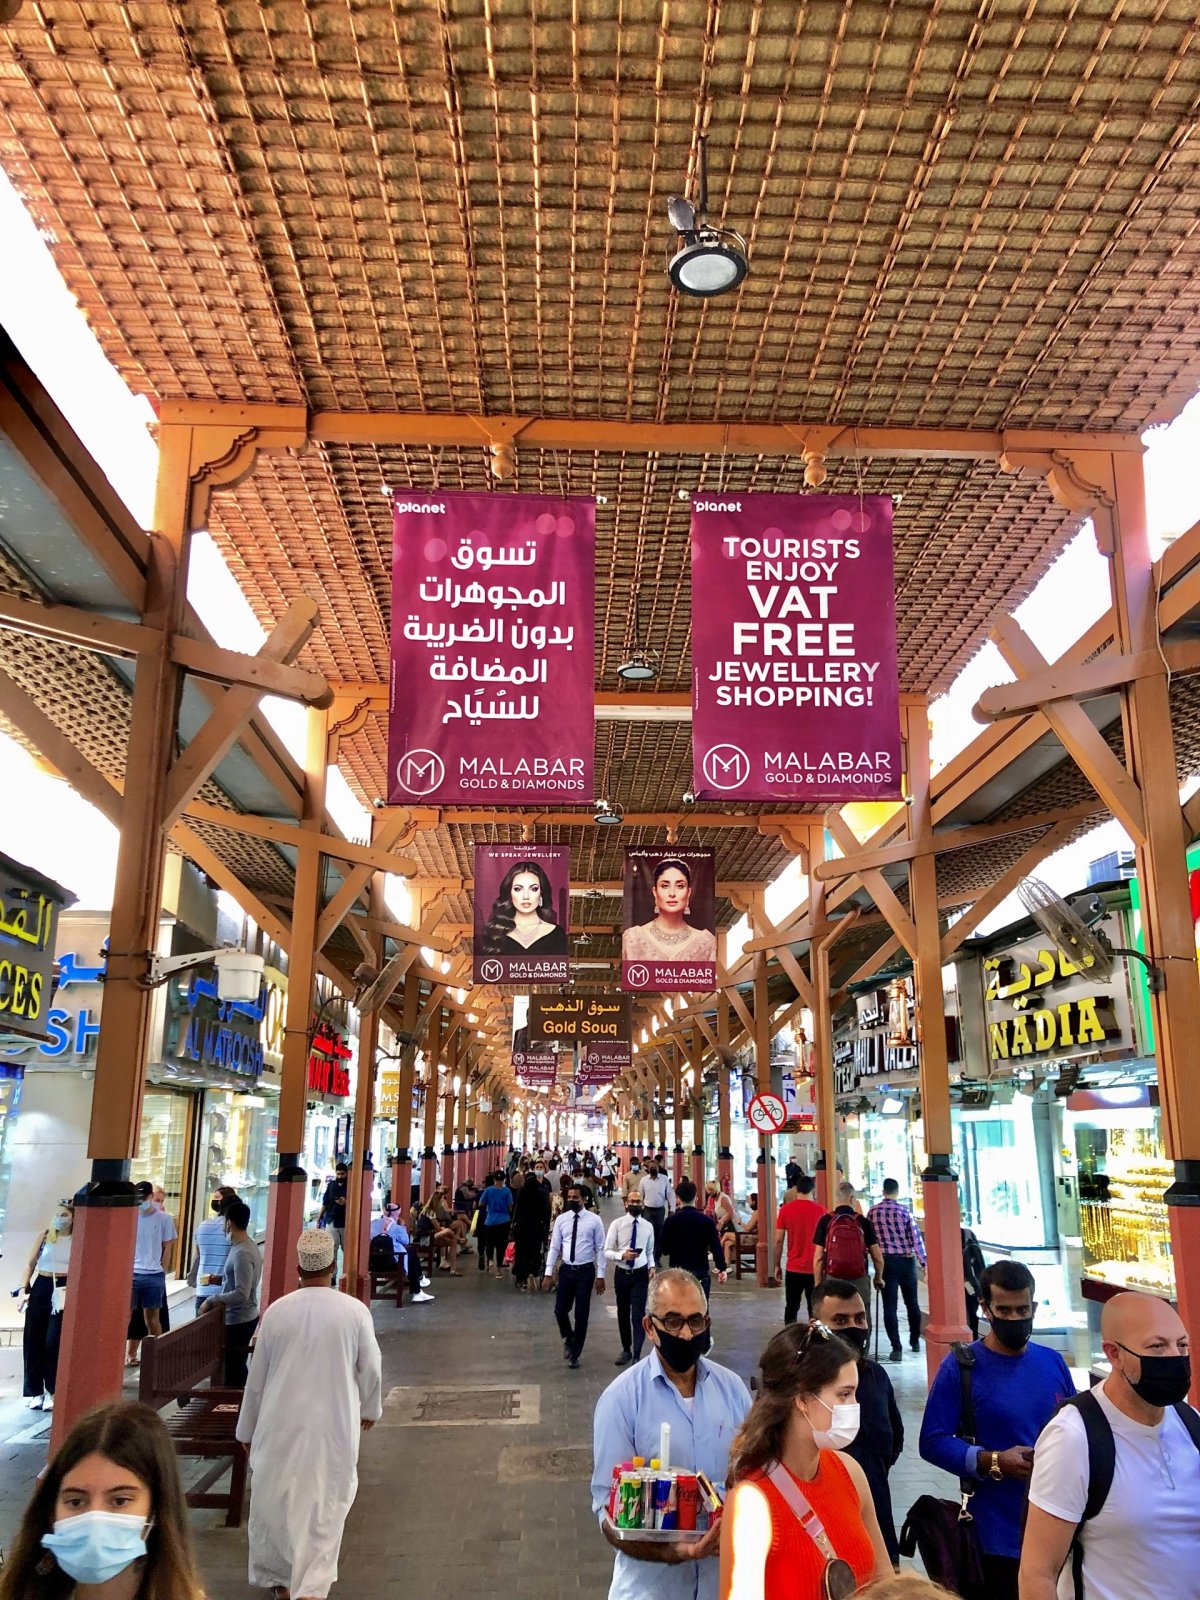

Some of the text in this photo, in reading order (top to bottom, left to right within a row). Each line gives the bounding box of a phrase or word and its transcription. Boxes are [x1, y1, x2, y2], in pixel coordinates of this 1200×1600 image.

[396, 502, 446, 514] planet
[693, 501, 742, 513] planet
[450, 538, 537, 571] تسوق
[723, 537, 860, 559] TOURISTS
[746, 560, 839, 582] ENJOY
[419, 576, 566, 612] المجوهرات
[747, 585, 838, 619] VAT
[403, 614, 574, 651] بدون الضريبة
[733, 622, 856, 657] FREE
[429, 654, 548, 685] المضافة
[708, 661, 880, 683] JEWELLERY
[716, 686, 873, 707] SHOPPING!
[459, 757, 585, 776] MALABAR
[764, 751, 891, 770] MALABAR
[459, 778, 585, 790] GOLD & DIAMONDS
[765, 772, 892, 784] GOLD & DIAMONDS
[509, 962, 567, 972] MALABAR
[655, 968, 713, 978] MALABAR
[540, 999, 620, 1015] سوق الذهب
[543, 1020, 618, 1036] Gold Souq
[989, 997, 1106, 1060] NADIA
